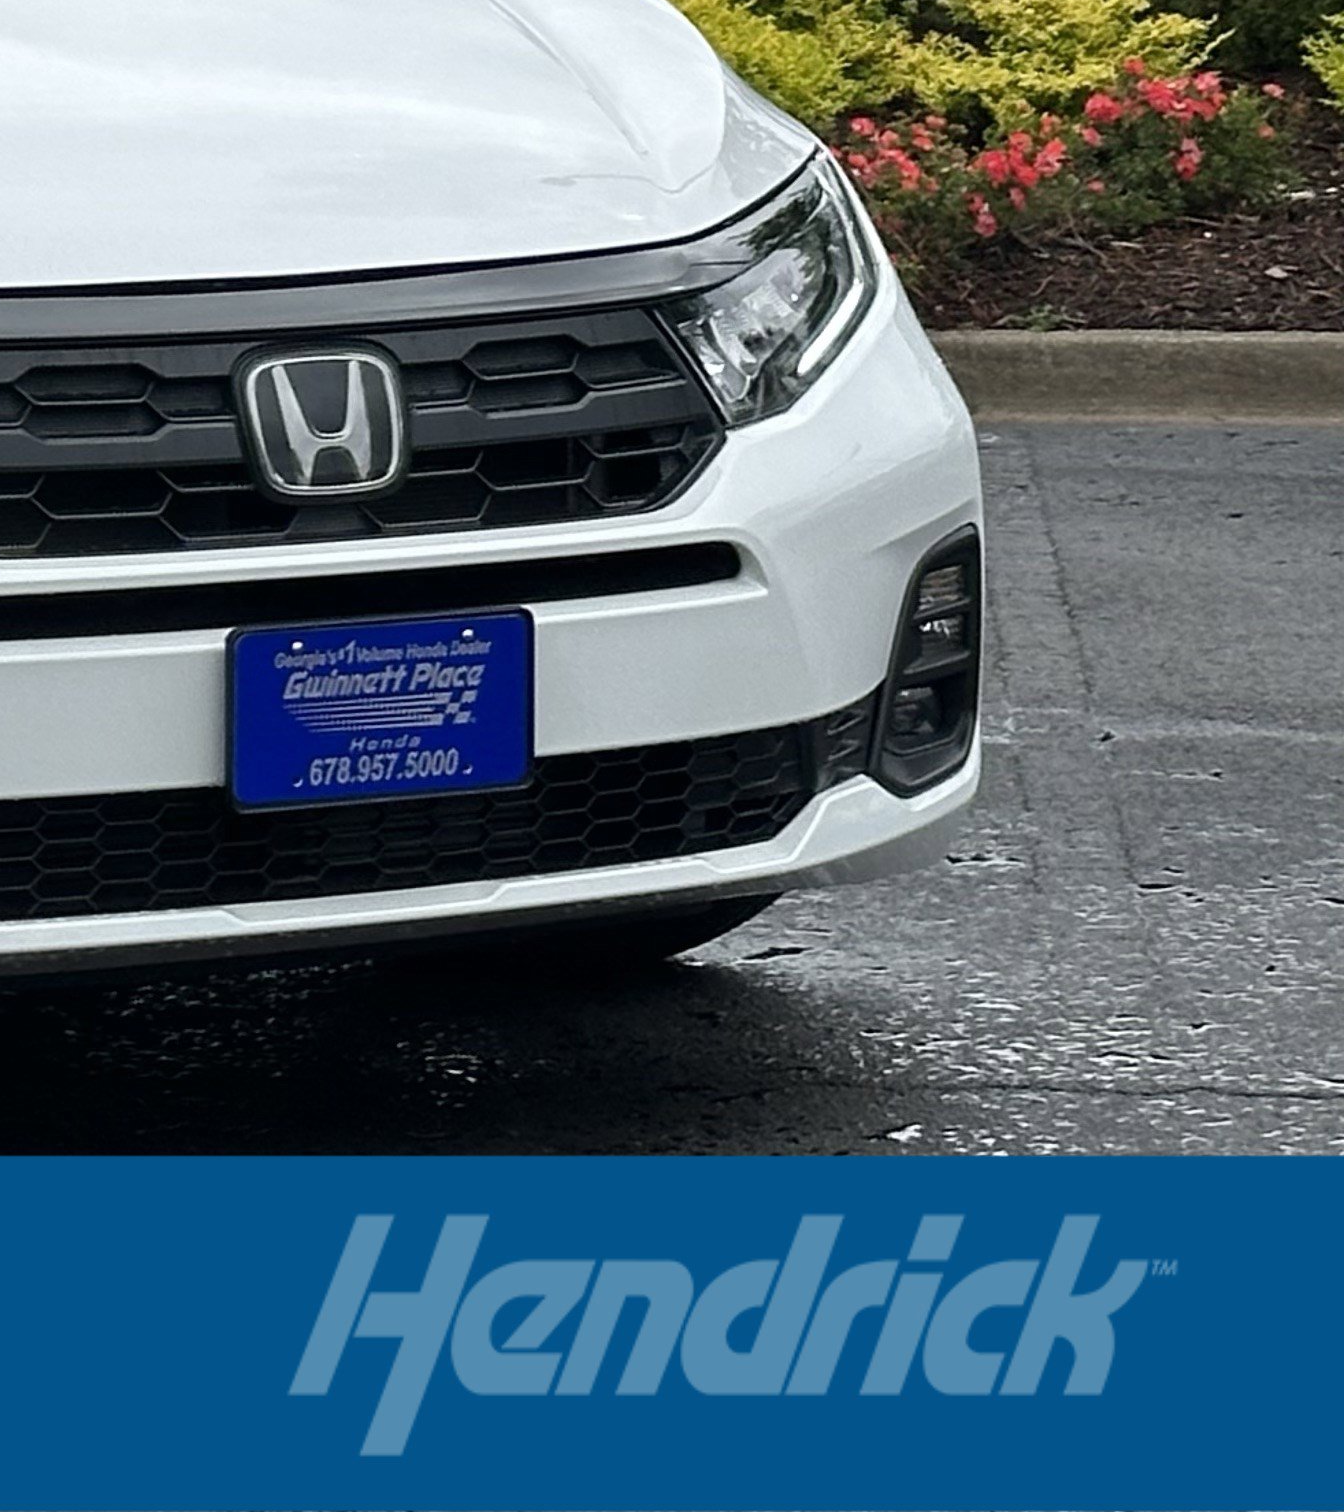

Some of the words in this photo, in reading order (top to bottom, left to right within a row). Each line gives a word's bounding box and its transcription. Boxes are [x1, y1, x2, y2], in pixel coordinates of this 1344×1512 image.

[274, 649, 336, 670] Georgia's
[406, 642, 448, 659] Honda
[449, 640, 492, 656] Dealer
[282, 664, 408, 700] Gwinnett
[409, 662, 485, 691] Place
[349, 734, 421, 753] Honda
[309, 748, 459, 786] 678.957.5000
